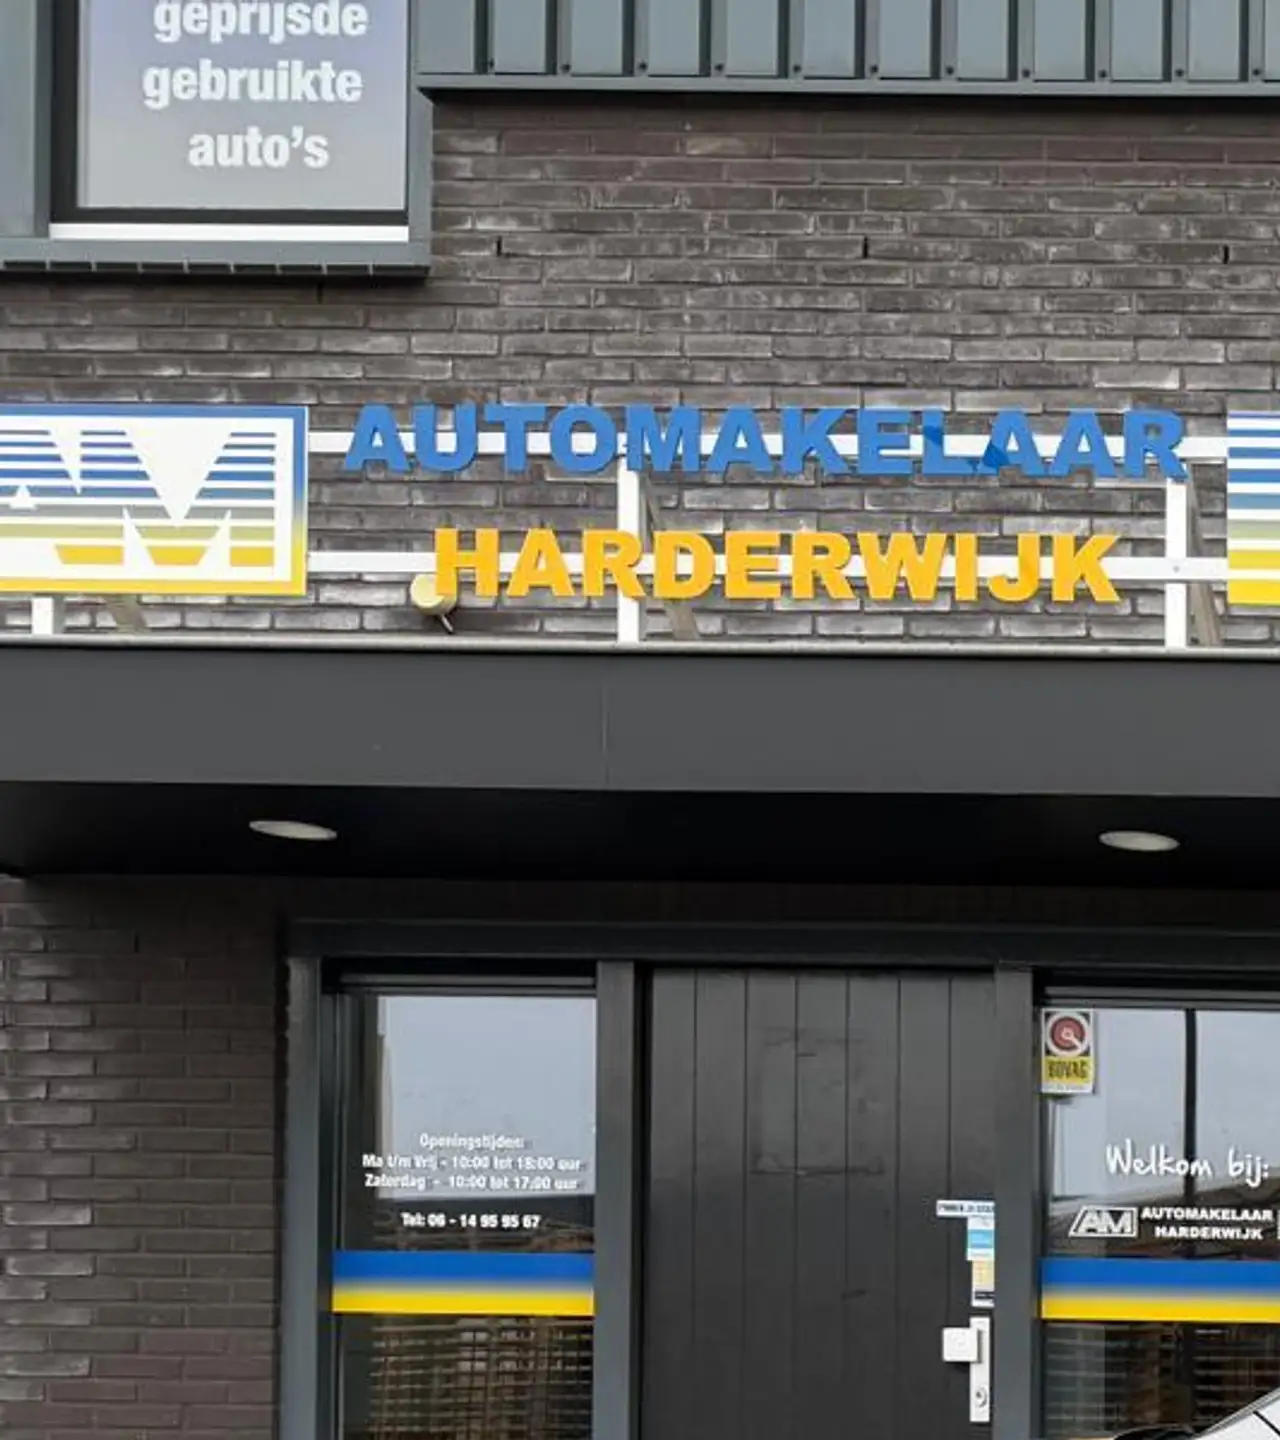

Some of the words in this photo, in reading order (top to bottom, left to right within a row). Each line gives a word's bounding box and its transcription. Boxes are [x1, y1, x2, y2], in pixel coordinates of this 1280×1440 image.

[153, 0, 369, 44] geprijsde
[142, 58, 364, 110] gebruikte
[344, 402, 1188, 480] AUTOMAKELAAR
[432, 526, 1121, 604] HARDERWIJK
[364, 1173, 427, 1190] Zaterdag
[1104, 1136, 1213, 1177] Welkom
[1227, 1144, 1270, 1189] bij:
[459, 1214, 477, 1228] 14
[1140, 1206, 1274, 1222] AUTOMAKELAAR
[1154, 1226, 1264, 1240] HARDERWIJK
